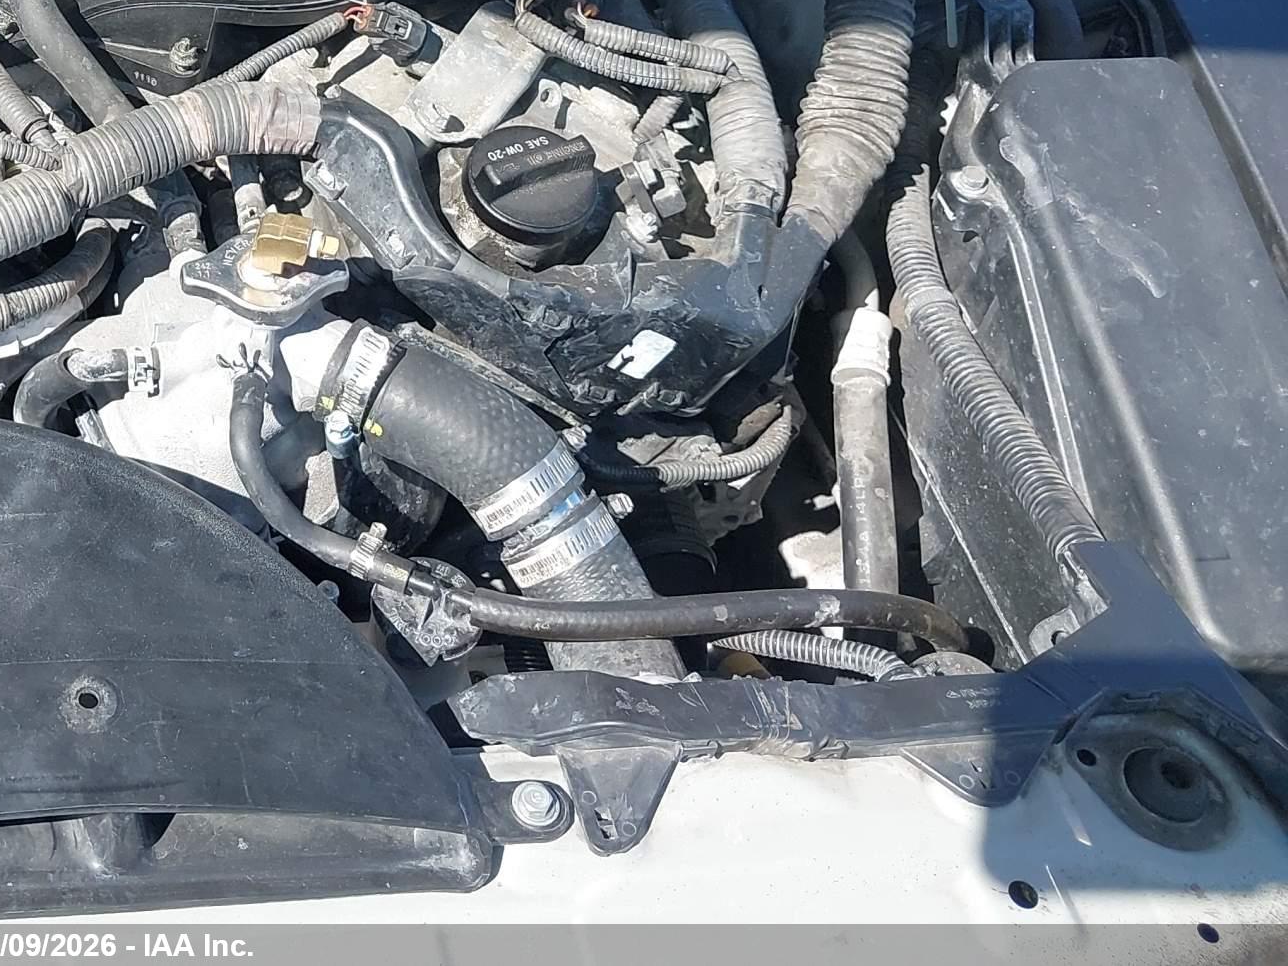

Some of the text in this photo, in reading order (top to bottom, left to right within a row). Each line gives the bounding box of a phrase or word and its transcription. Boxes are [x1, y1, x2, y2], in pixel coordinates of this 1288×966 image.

[487, 136, 550, 162] SAE 0W-20
[222, 239, 251, 267] NEVER
